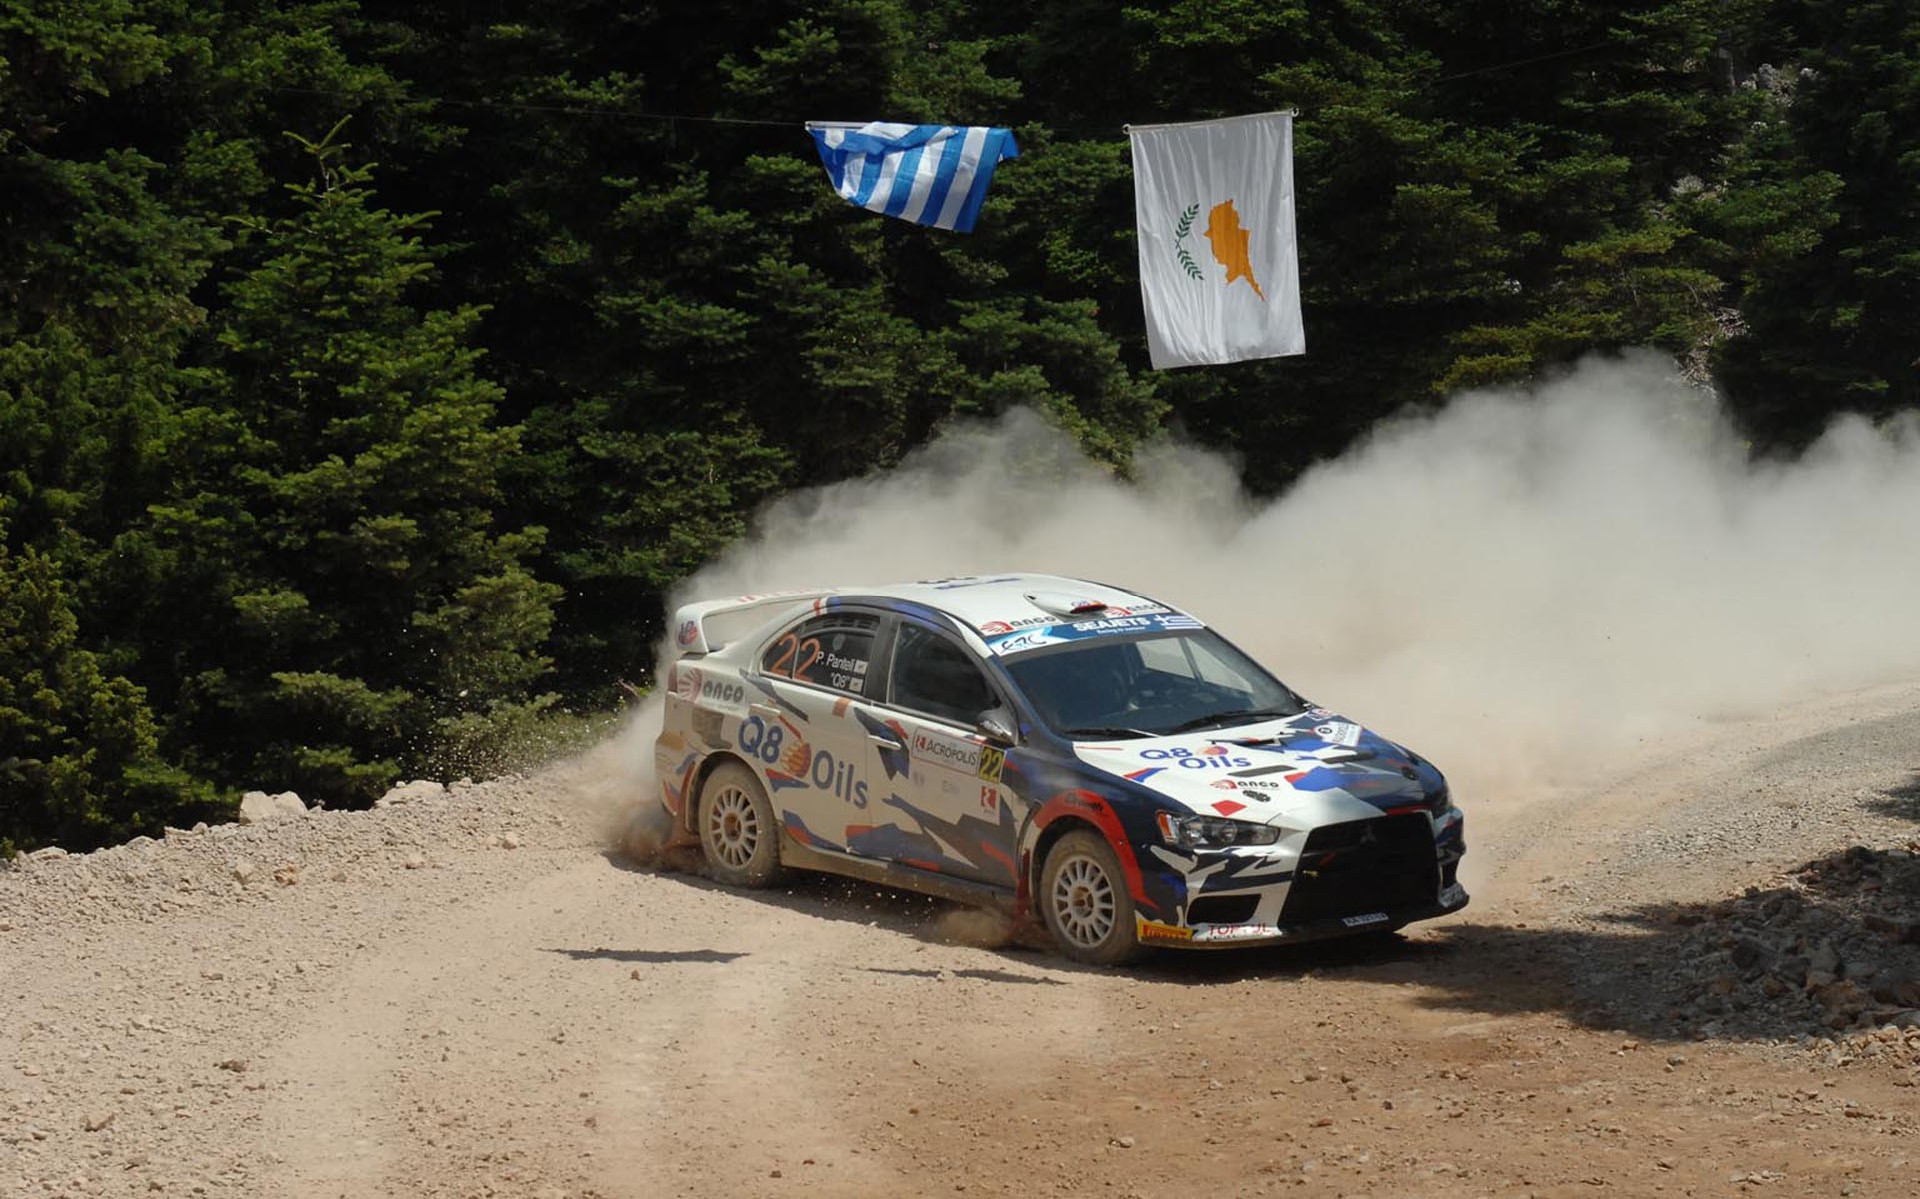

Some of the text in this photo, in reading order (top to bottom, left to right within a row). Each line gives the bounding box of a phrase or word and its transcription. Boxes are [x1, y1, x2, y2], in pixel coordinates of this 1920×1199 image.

[1072, 616, 1152, 632] SEAJETS
[771, 632, 821, 683] 22
[738, 714, 783, 764] Q8
[926, 738, 979, 767] ACROPOLIS
[979, 747, 1004, 783] 22
[1139, 747, 1194, 761] Q8
[1178, 755, 1252, 769] Oils
[812, 749, 868, 810] Oils
[1236, 780, 1280, 789] anco
